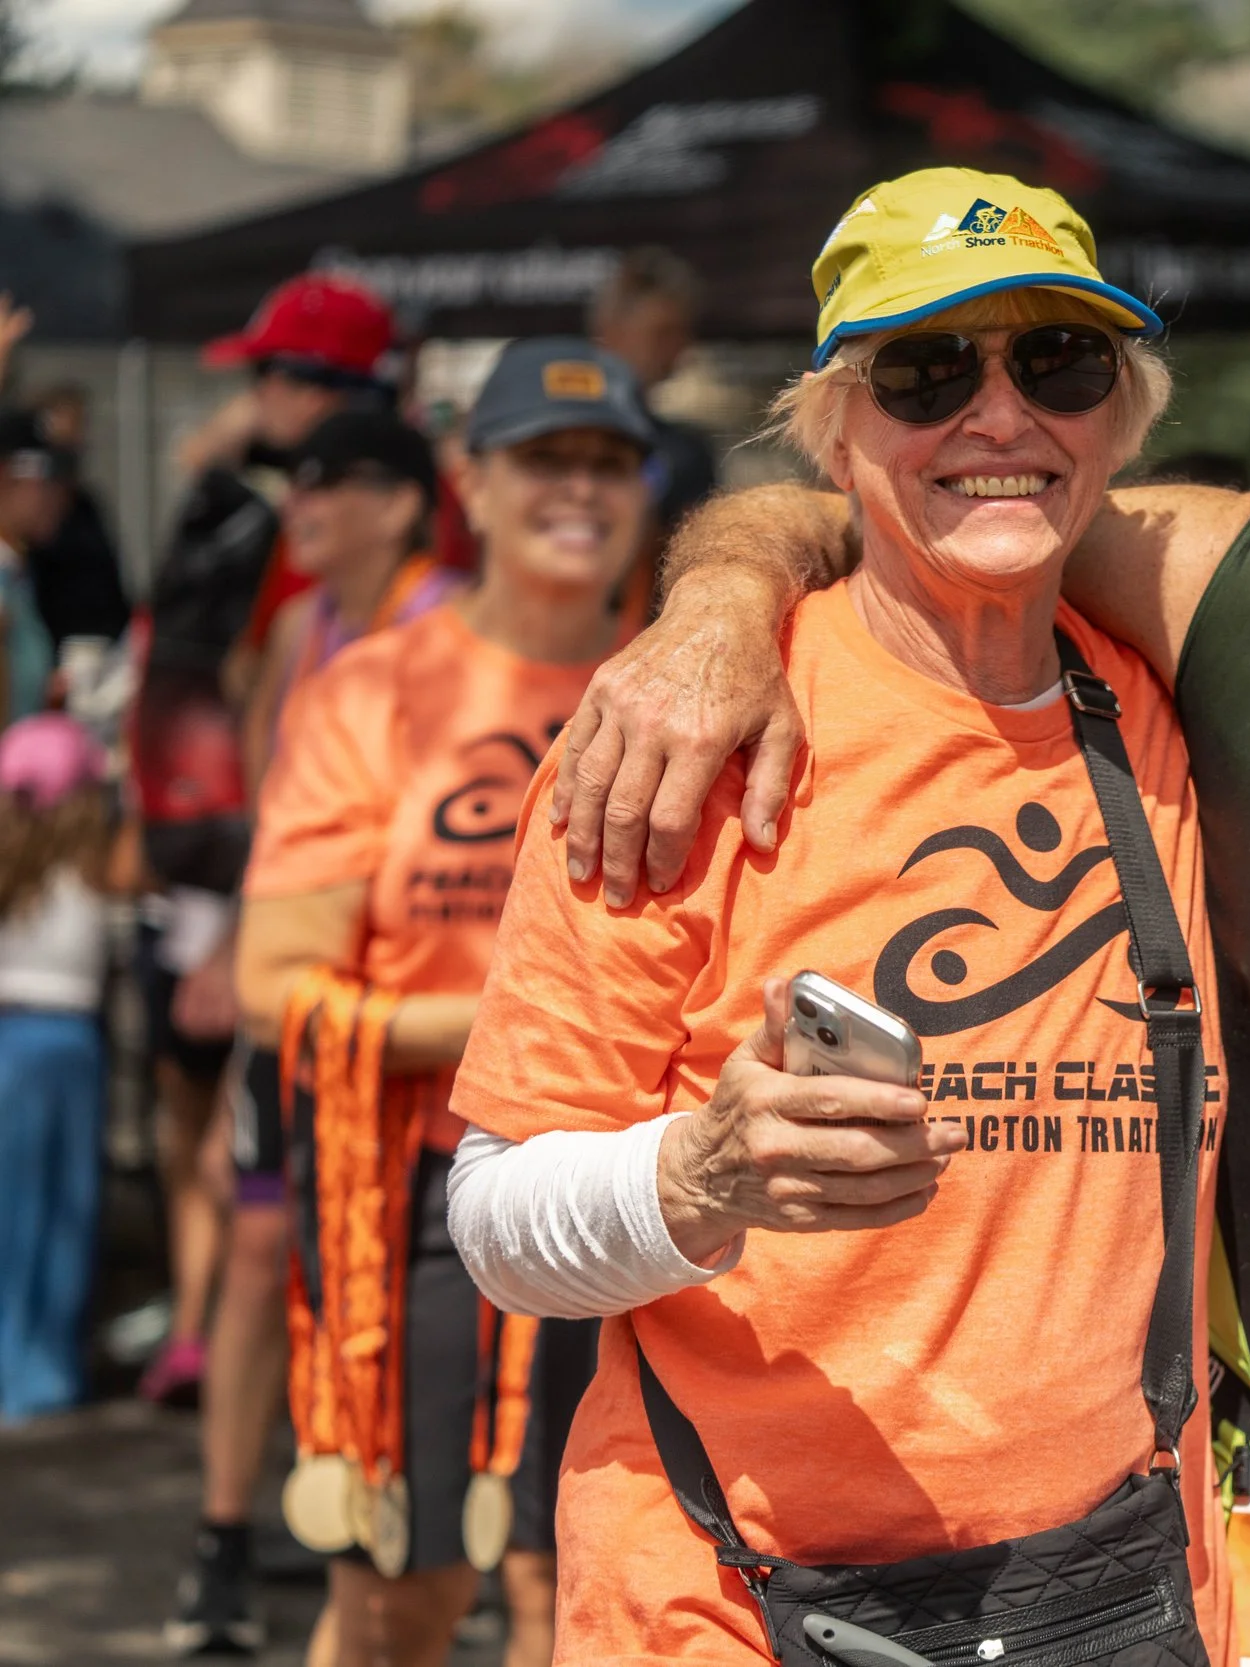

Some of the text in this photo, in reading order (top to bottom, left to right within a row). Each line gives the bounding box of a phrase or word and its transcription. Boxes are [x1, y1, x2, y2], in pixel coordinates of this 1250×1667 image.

[921, 235, 1065, 258] North Shore Triathlon
[921, 1061, 1037, 1101] EACH
